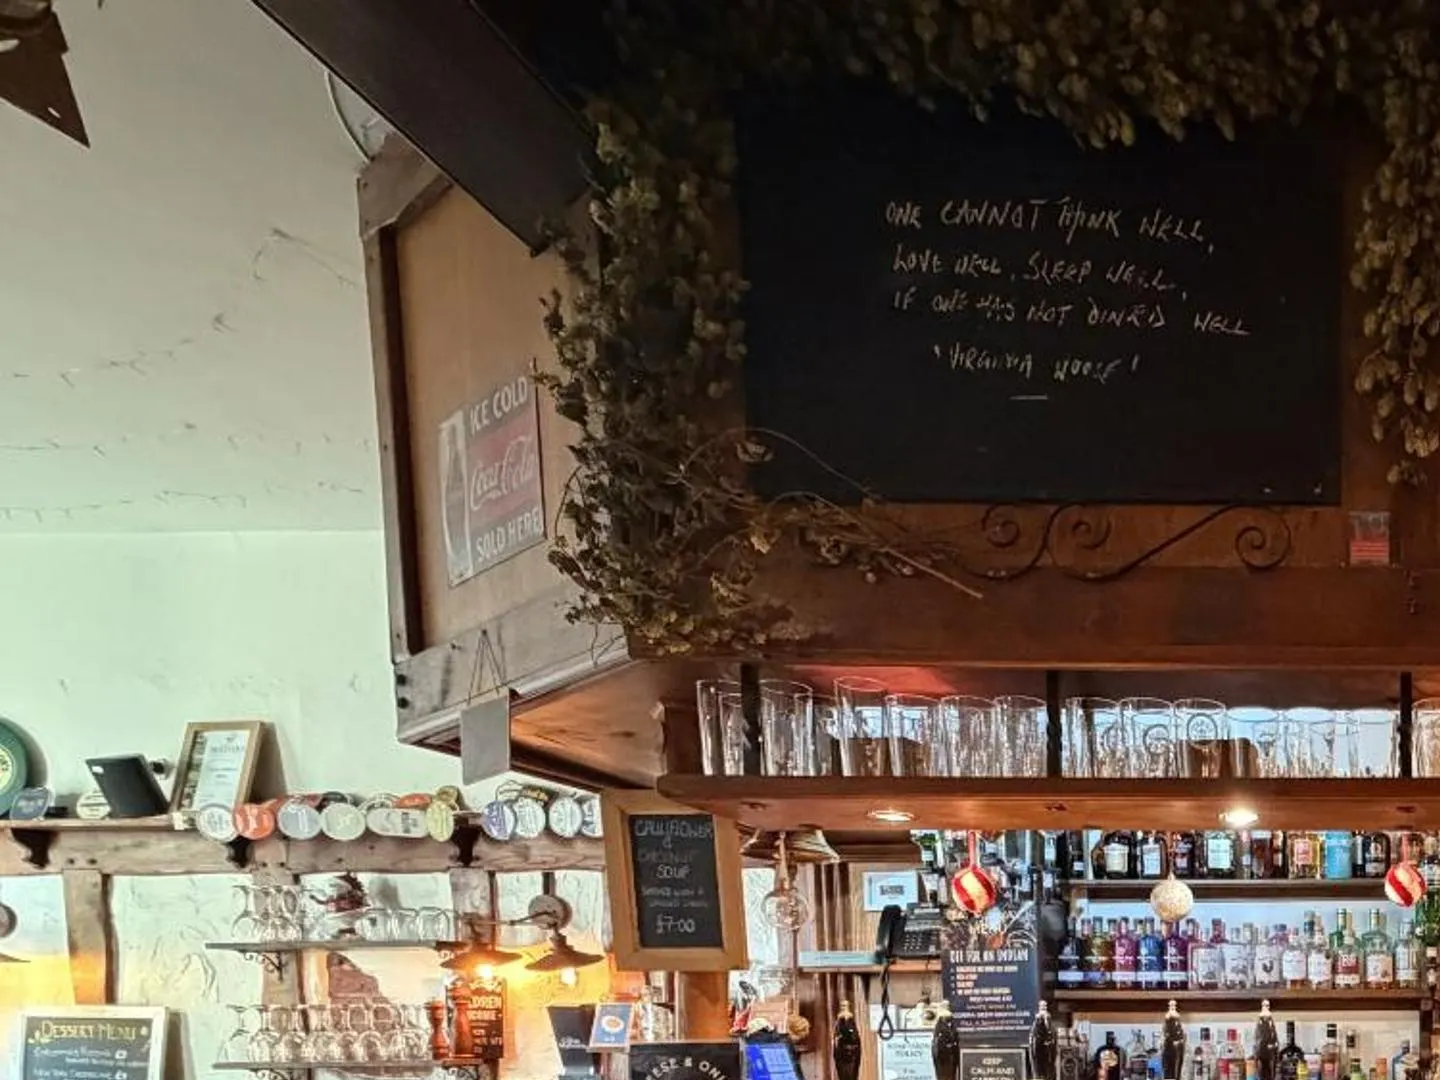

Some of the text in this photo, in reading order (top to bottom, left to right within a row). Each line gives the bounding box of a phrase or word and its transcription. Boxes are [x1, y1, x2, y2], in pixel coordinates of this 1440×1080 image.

[940, 198, 1049, 232] CANNOT
[893, 243, 942, 275] LOVE
[894, 286, 917, 311] IF
[1026, 302, 1075, 328] NOT
[470, 375, 529, 437] ICE COLD
[475, 505, 542, 563] SOLD HERE
